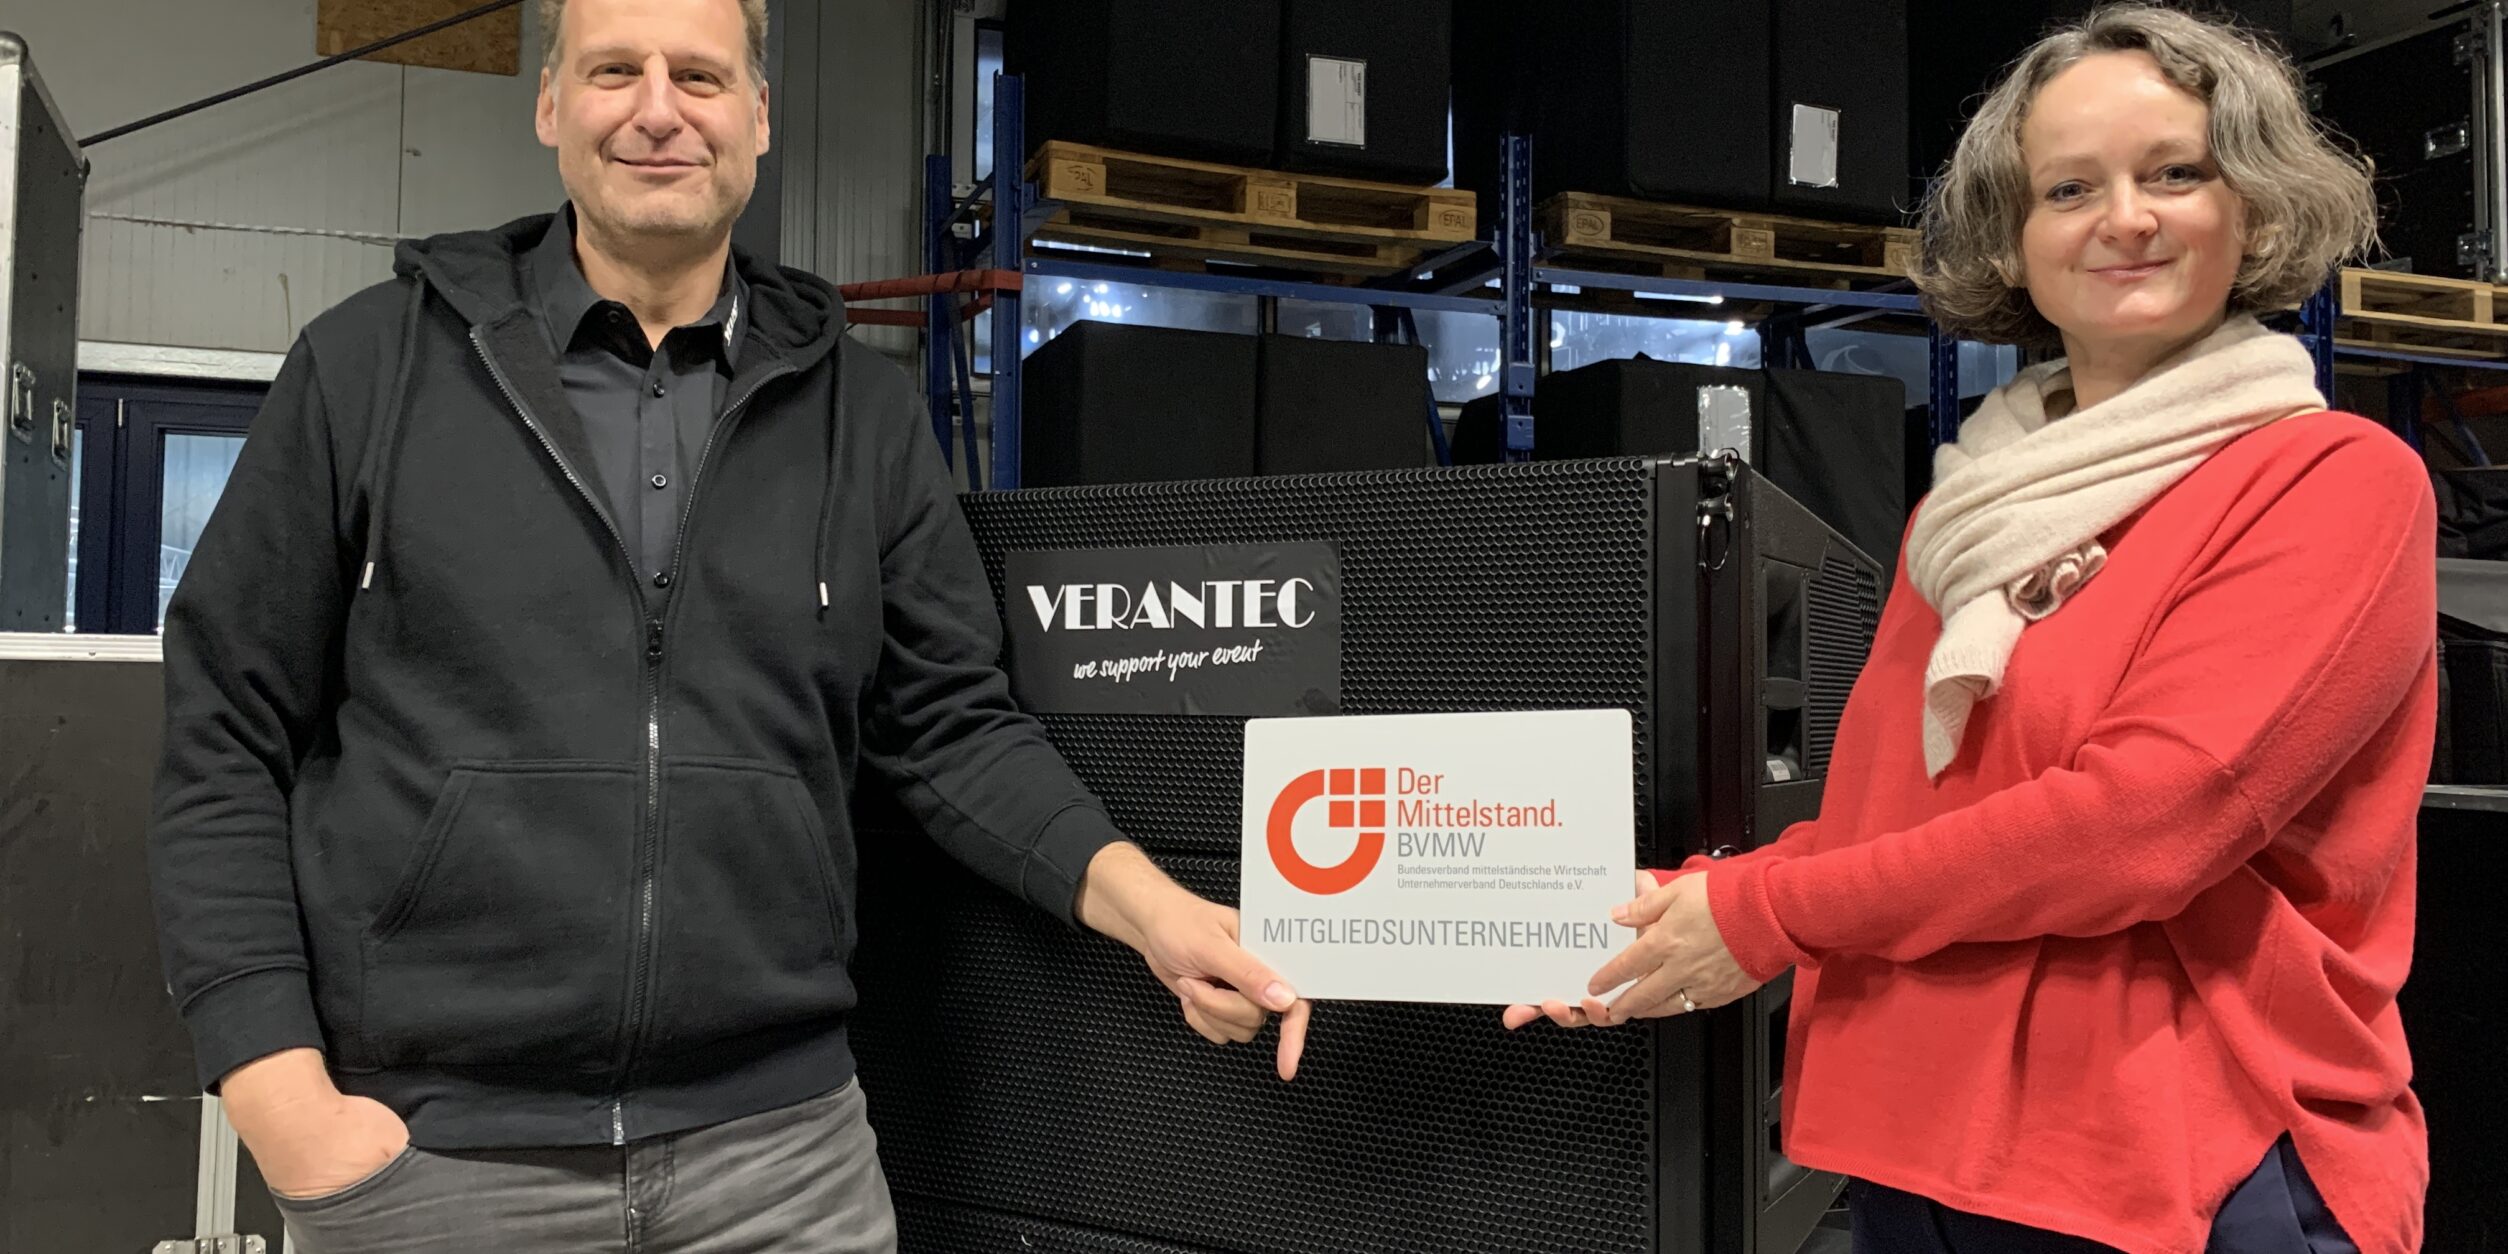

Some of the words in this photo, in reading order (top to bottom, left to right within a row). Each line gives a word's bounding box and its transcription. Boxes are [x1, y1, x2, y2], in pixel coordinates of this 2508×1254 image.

[1027, 577, 1316, 633] VERANTEC
[1073, 659, 1098, 680] we
[1099, 649, 1166, 683] support
[1167, 648, 1209, 682] your
[1212, 638, 1263, 665] event
[1398, 767, 1444, 795] Der
[1398, 798, 1563, 828] Mittelstand.
[1397, 832, 1486, 857] BVMW
[1397, 864, 1470, 876] Bundesverband
[1472, 865, 1552, 876] mittelständische
[1553, 865, 1607, 877] Wirtschaft
[1397, 879, 1496, 890] Unternehmerverband
[1498, 879, 1565, 891] Deutschlands
[1566, 880, 1584, 891] e.V.
[1263, 918, 1608, 949] MITGLIEDSUNTERNEHMEN
